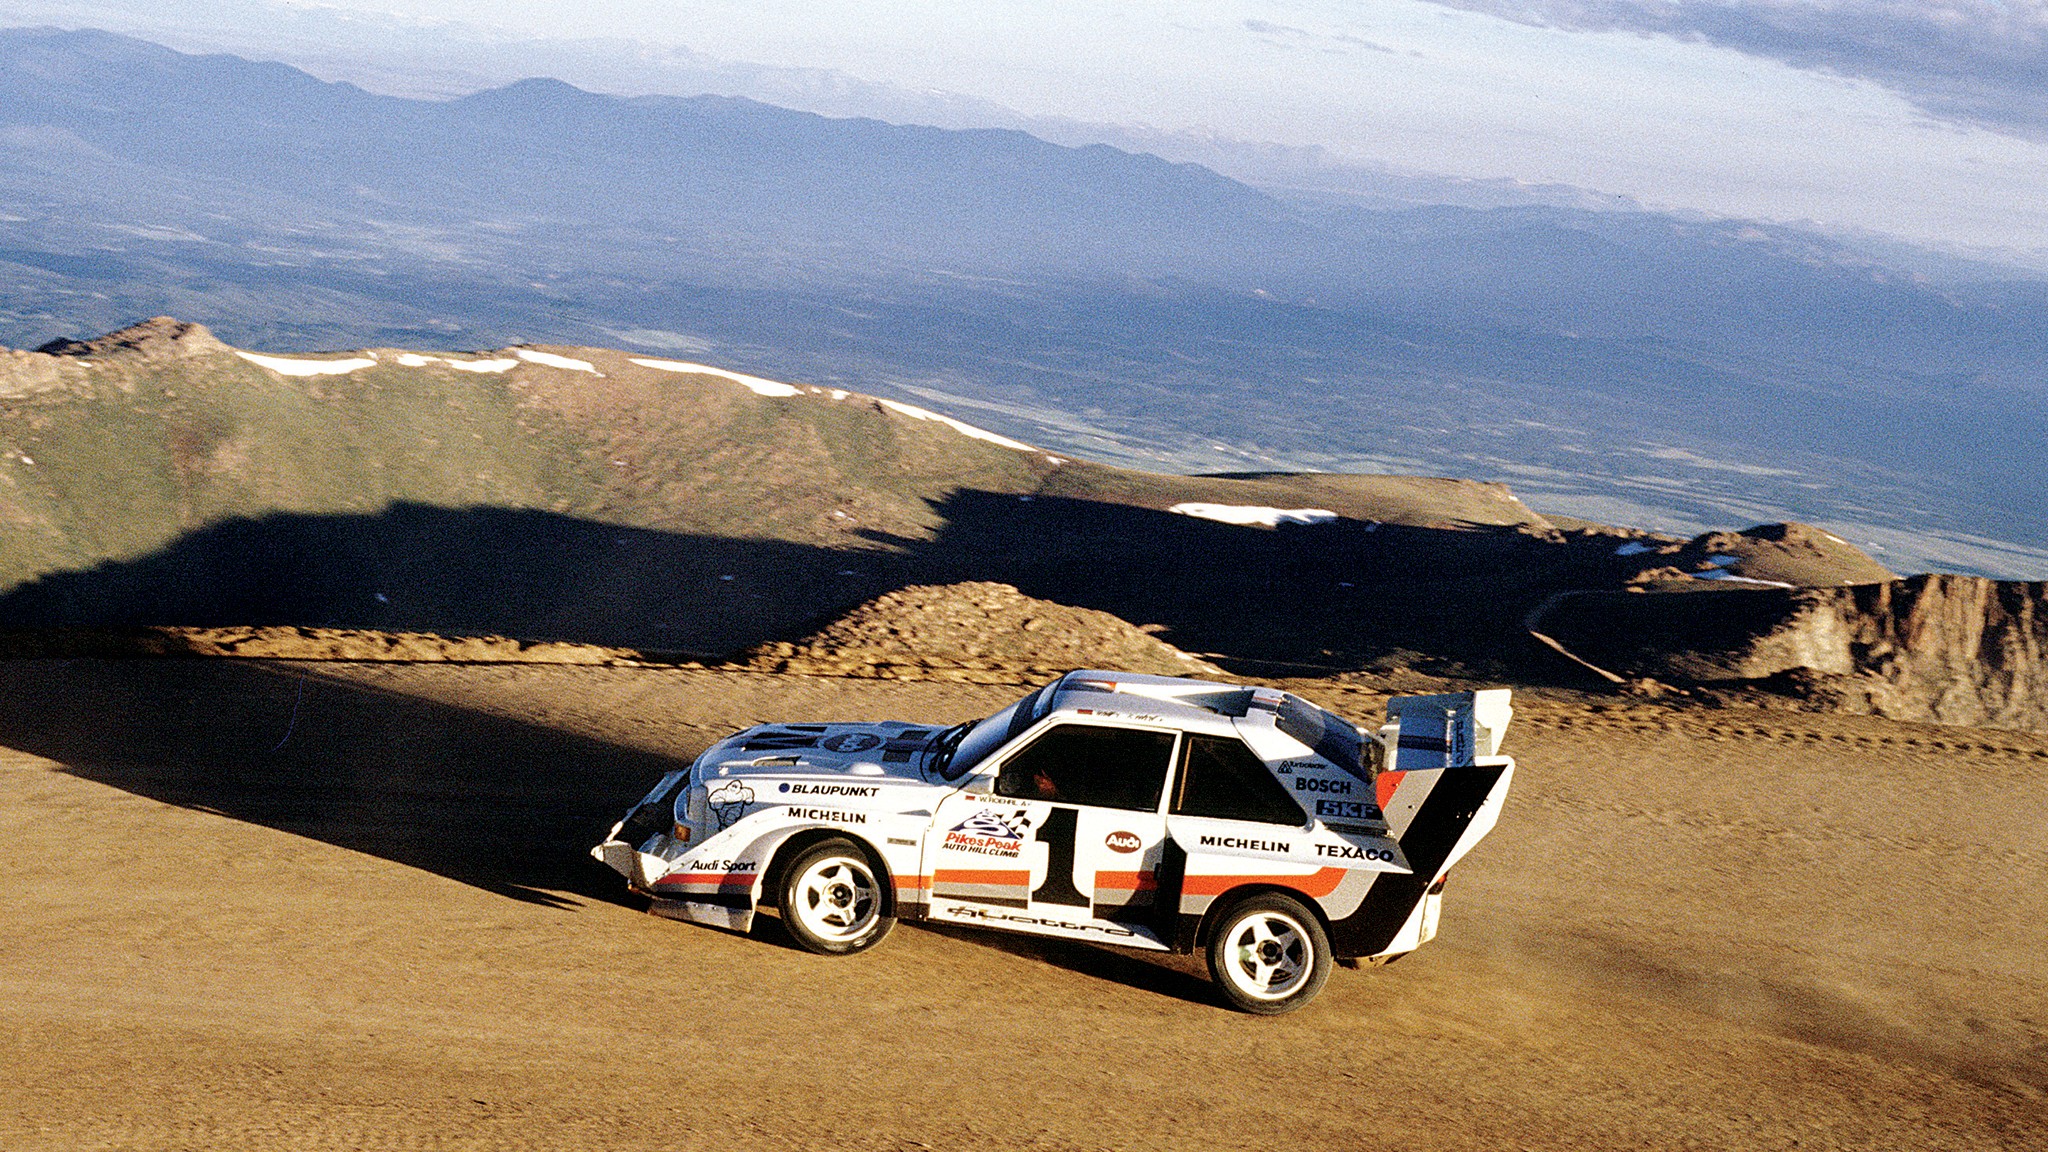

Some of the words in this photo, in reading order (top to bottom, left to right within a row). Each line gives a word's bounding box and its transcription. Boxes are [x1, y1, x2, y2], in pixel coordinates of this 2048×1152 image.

[791, 784, 880, 797] BLAUPUNKT
[1296, 777, 1351, 794] BOSCH
[788, 807, 866, 824] MICHELIN
[1322, 801, 1377, 818] SKF
[945, 832, 984, 847] Pikes
[985, 837, 1022, 851] Peak
[1106, 832, 1141, 849] Audi
[1200, 836, 1290, 853] MICHELIN
[942, 843, 967, 852] AUTO
[968, 847, 988, 855] HILL
[989, 849, 1019, 858] CLIMB
[1032, 806, 1090, 908] 1
[1315, 844, 1394, 863] TEXACO
[690, 860, 720, 871] Audi
[721, 860, 756, 873] Sport
[947, 906, 1134, 937] quattro
